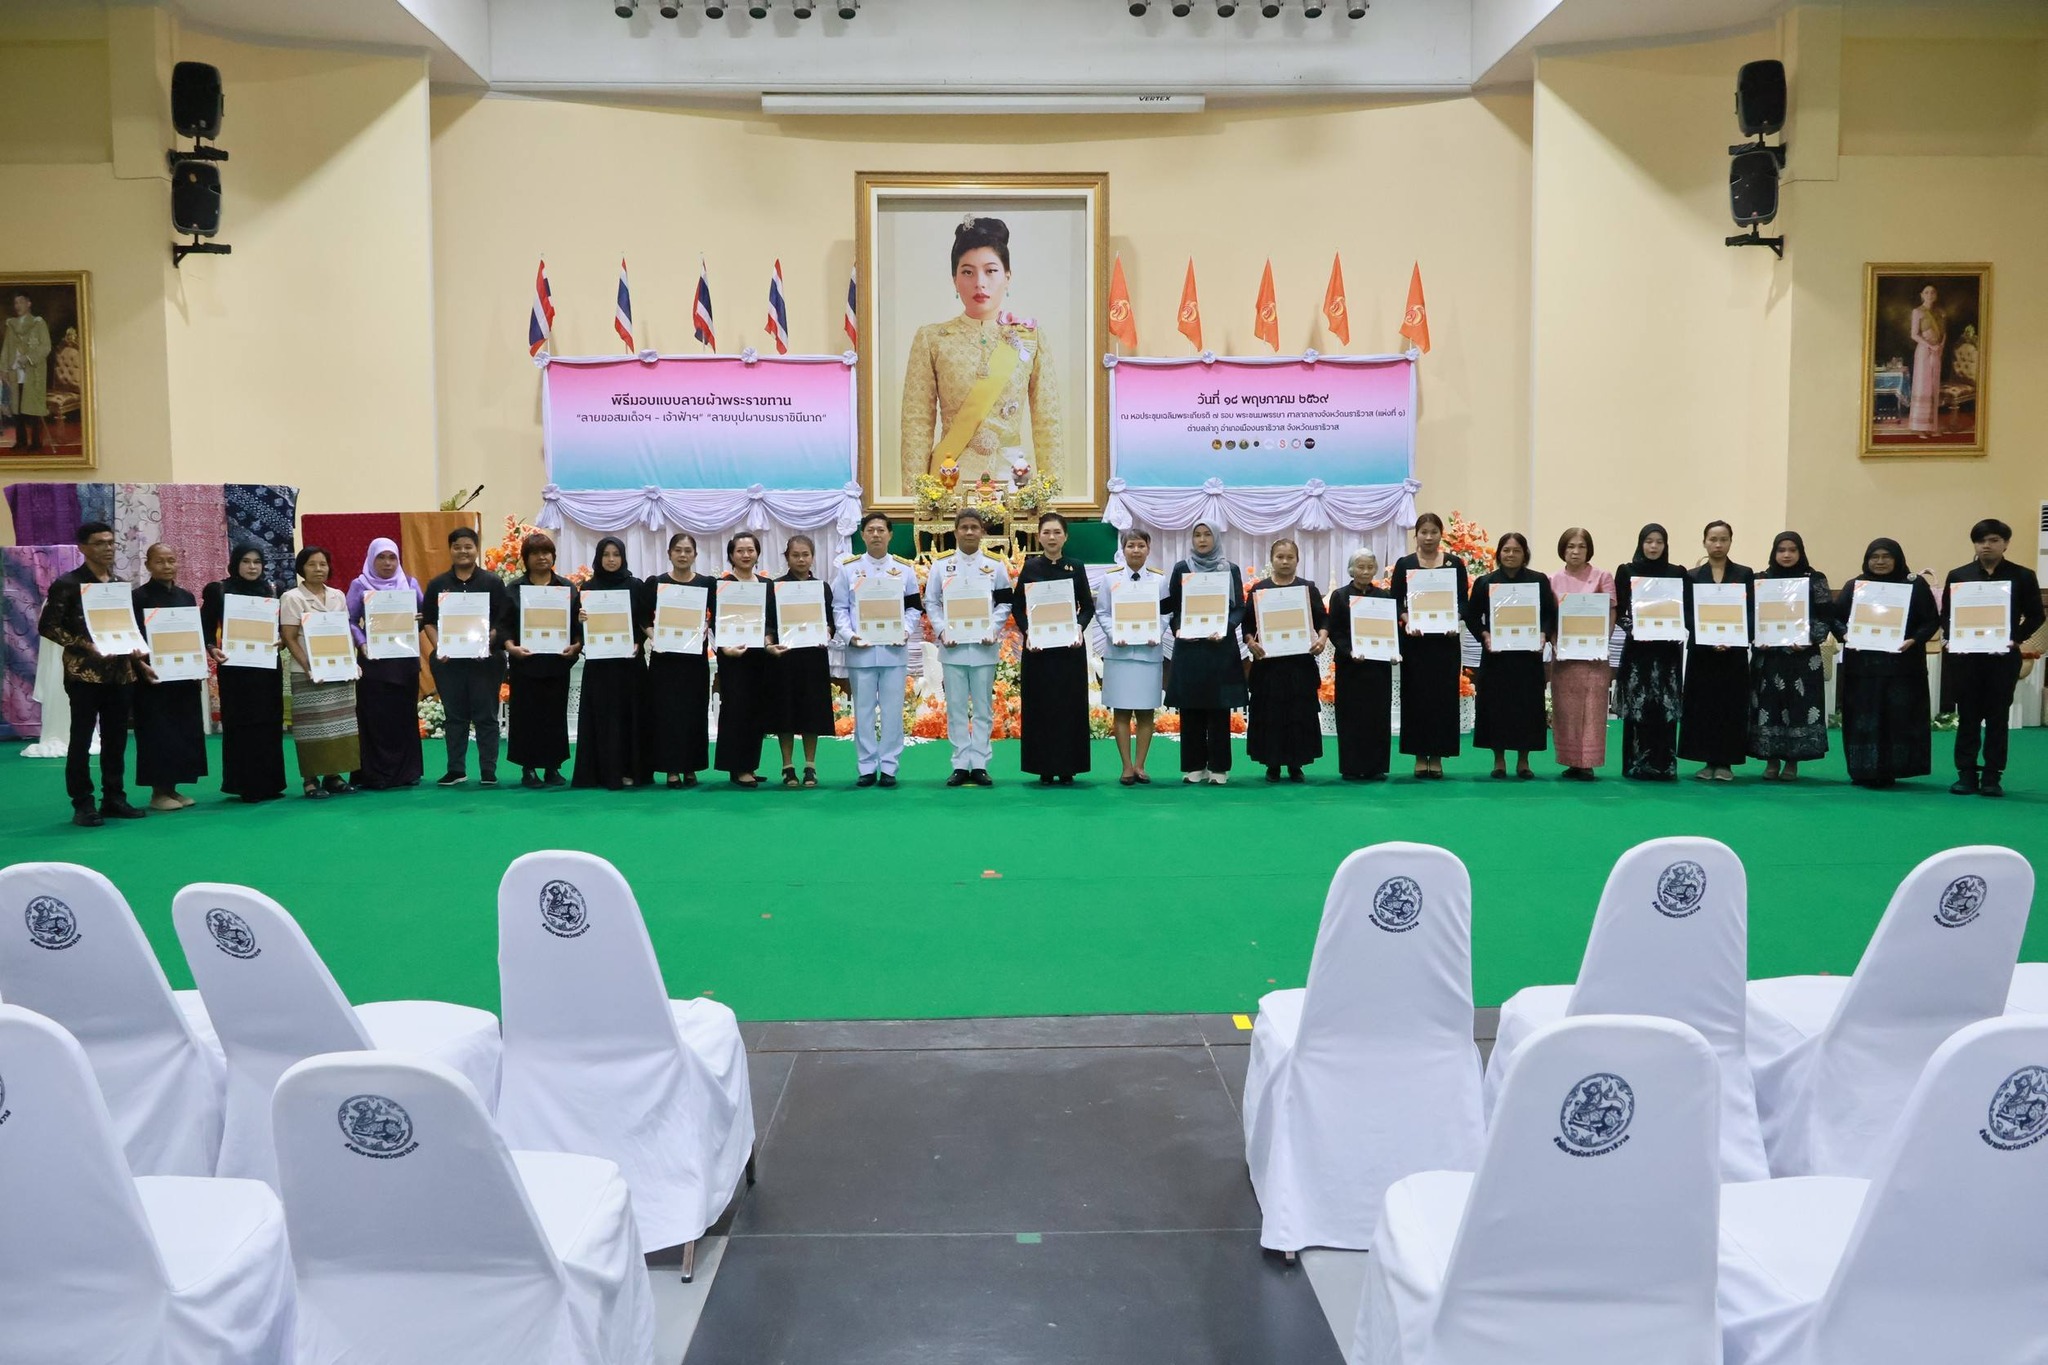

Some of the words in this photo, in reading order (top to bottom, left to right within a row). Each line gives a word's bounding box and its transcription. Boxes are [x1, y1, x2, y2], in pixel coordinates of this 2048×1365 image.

[611, 393, 792, 406] พิธีมอบแบบลายผ้าพระราชทาน
[1197, 390, 1220, 405] วันที่
[1224, 395, 1238, 405] ๑๘
[1241, 394, 1295, 407] พฤษภาคม
[1298, 394, 1329, 404] ๒๕๖๙
